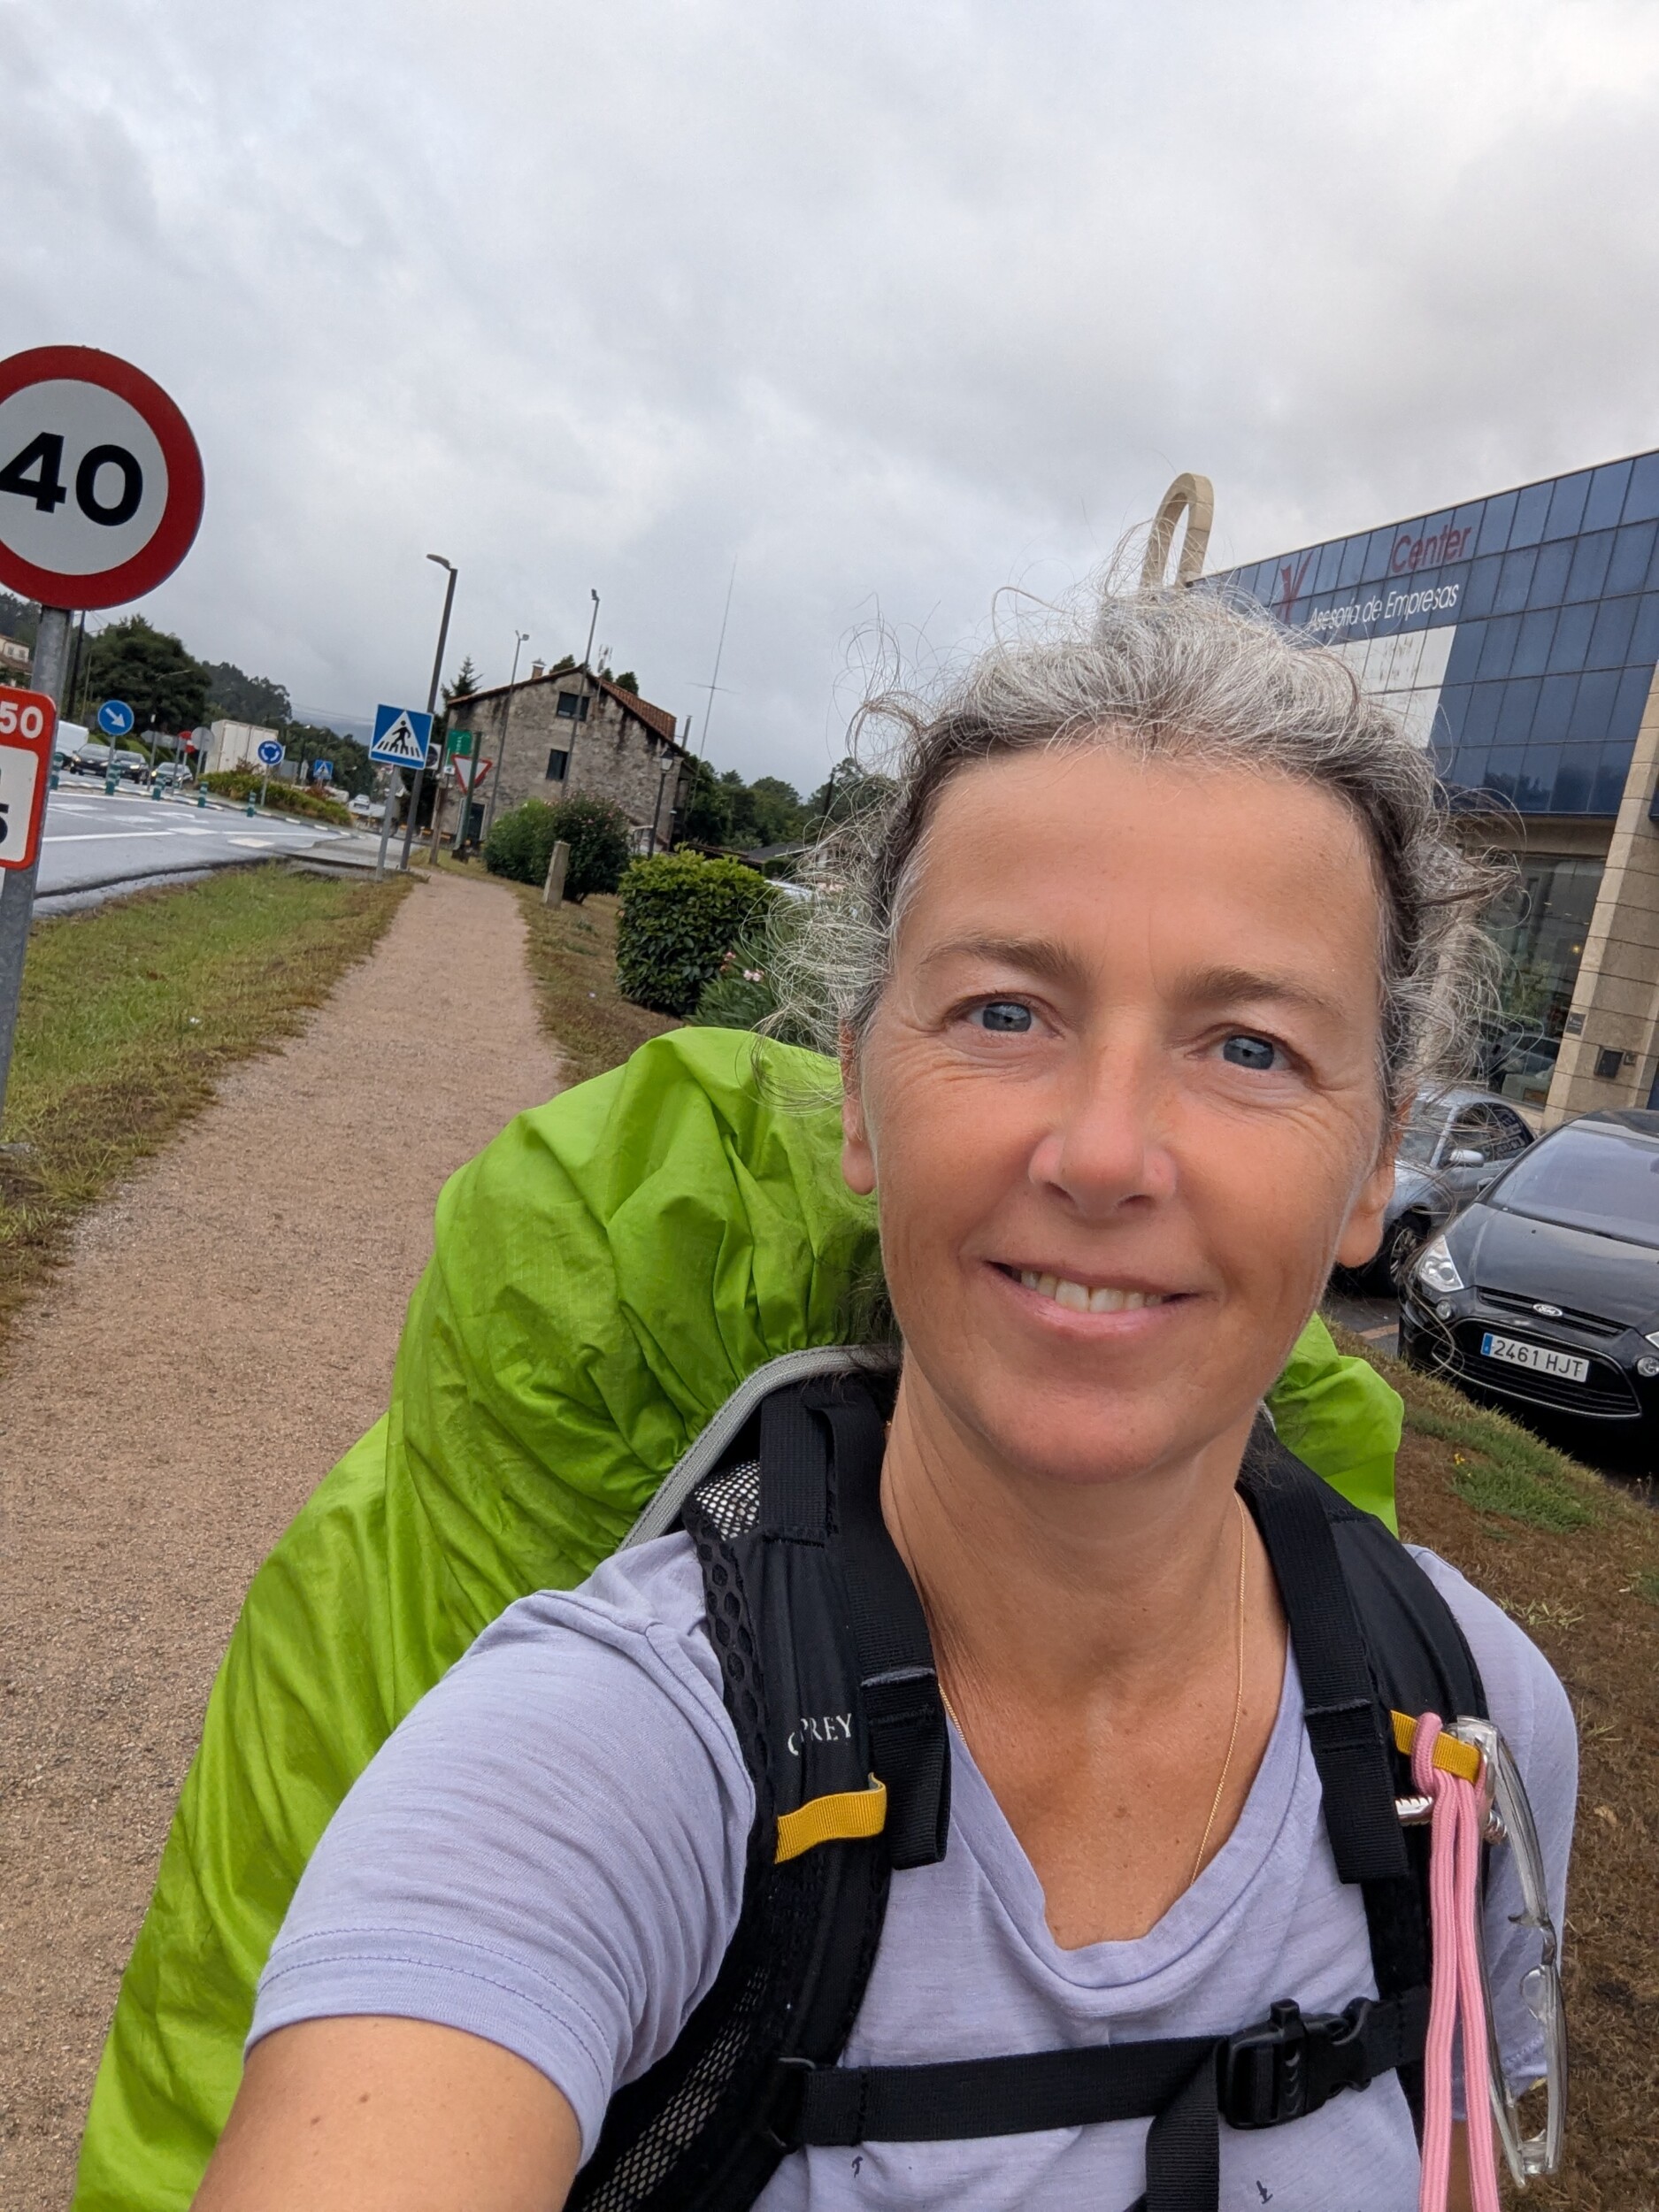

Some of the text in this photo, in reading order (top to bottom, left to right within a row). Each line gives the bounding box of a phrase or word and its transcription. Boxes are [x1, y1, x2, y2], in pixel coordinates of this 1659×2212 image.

[0, 432, 143, 526] 40
[1392, 525, 1472, 573] Center
[1362, 595, 1382, 621] de
[1384, 583, 1459, 621] Empresas
[1494, 1340, 1583, 1377] 2461 HJT
